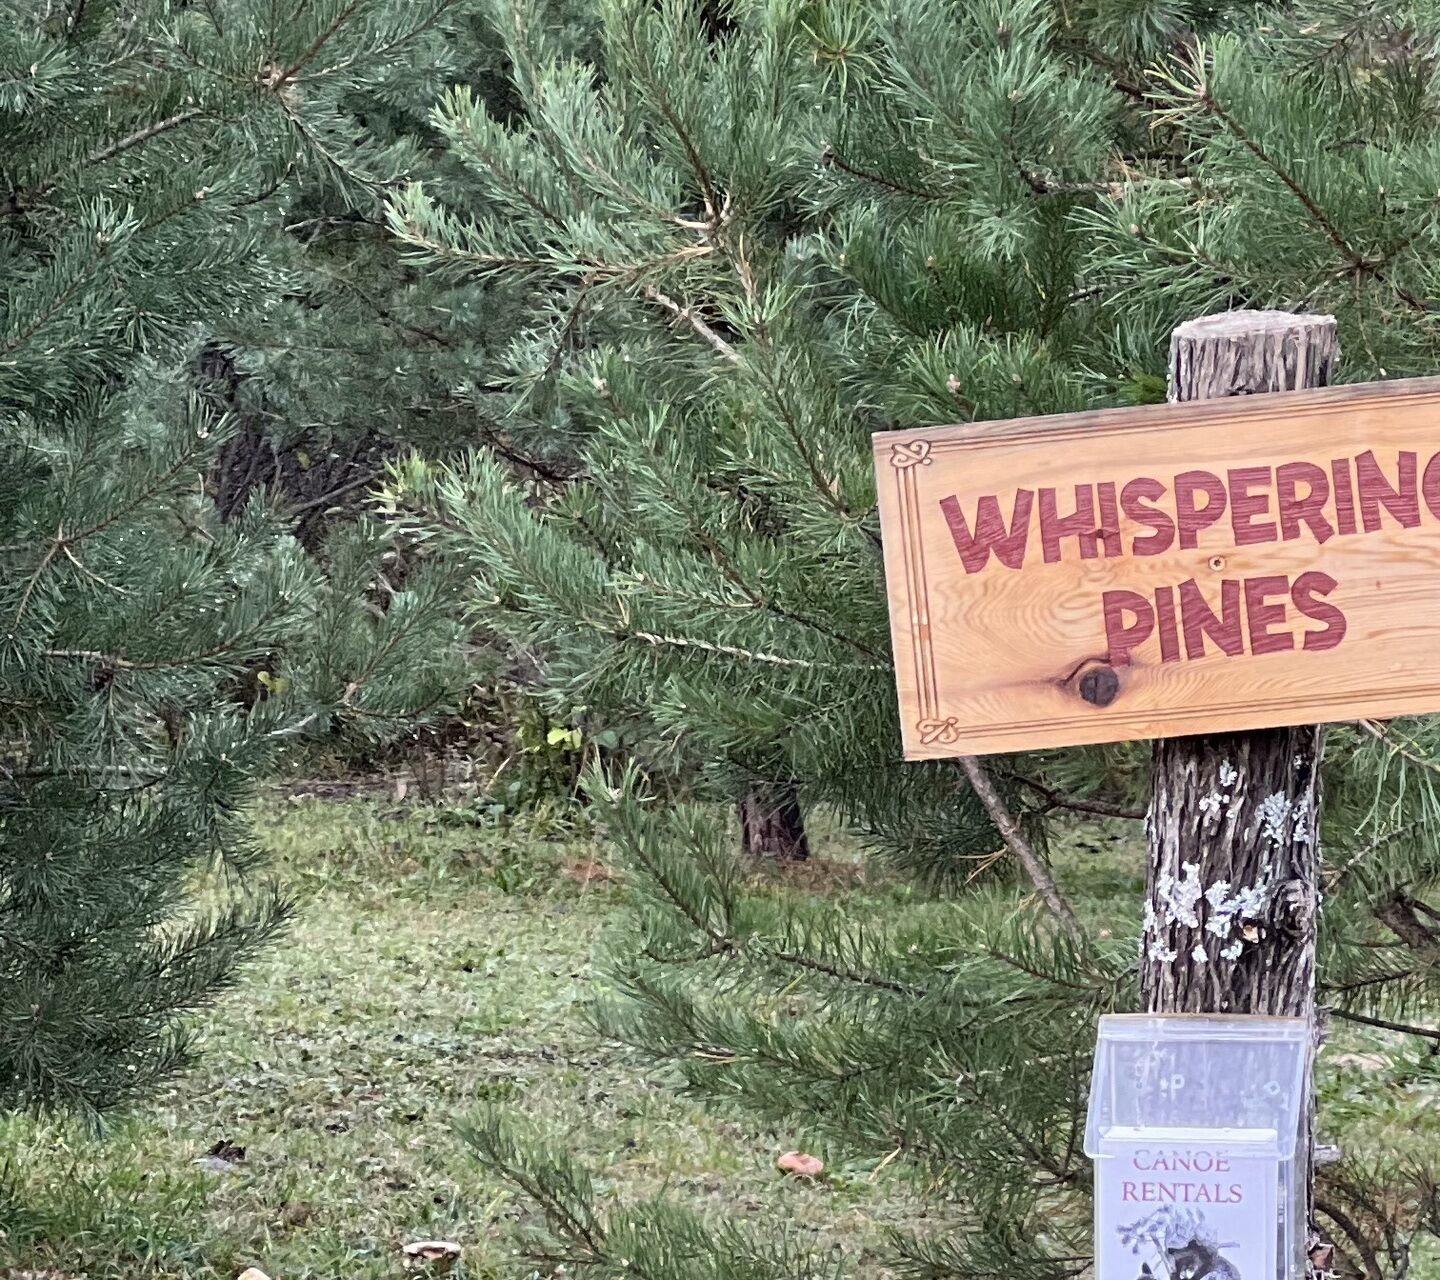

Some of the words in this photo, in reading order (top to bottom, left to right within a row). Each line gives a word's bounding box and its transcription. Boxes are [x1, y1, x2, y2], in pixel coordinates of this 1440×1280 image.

[1102, 571, 1347, 666] PINES
[1132, 1150, 1231, 1172] CANOE
[1121, 1181, 1243, 1204] RENTALS
